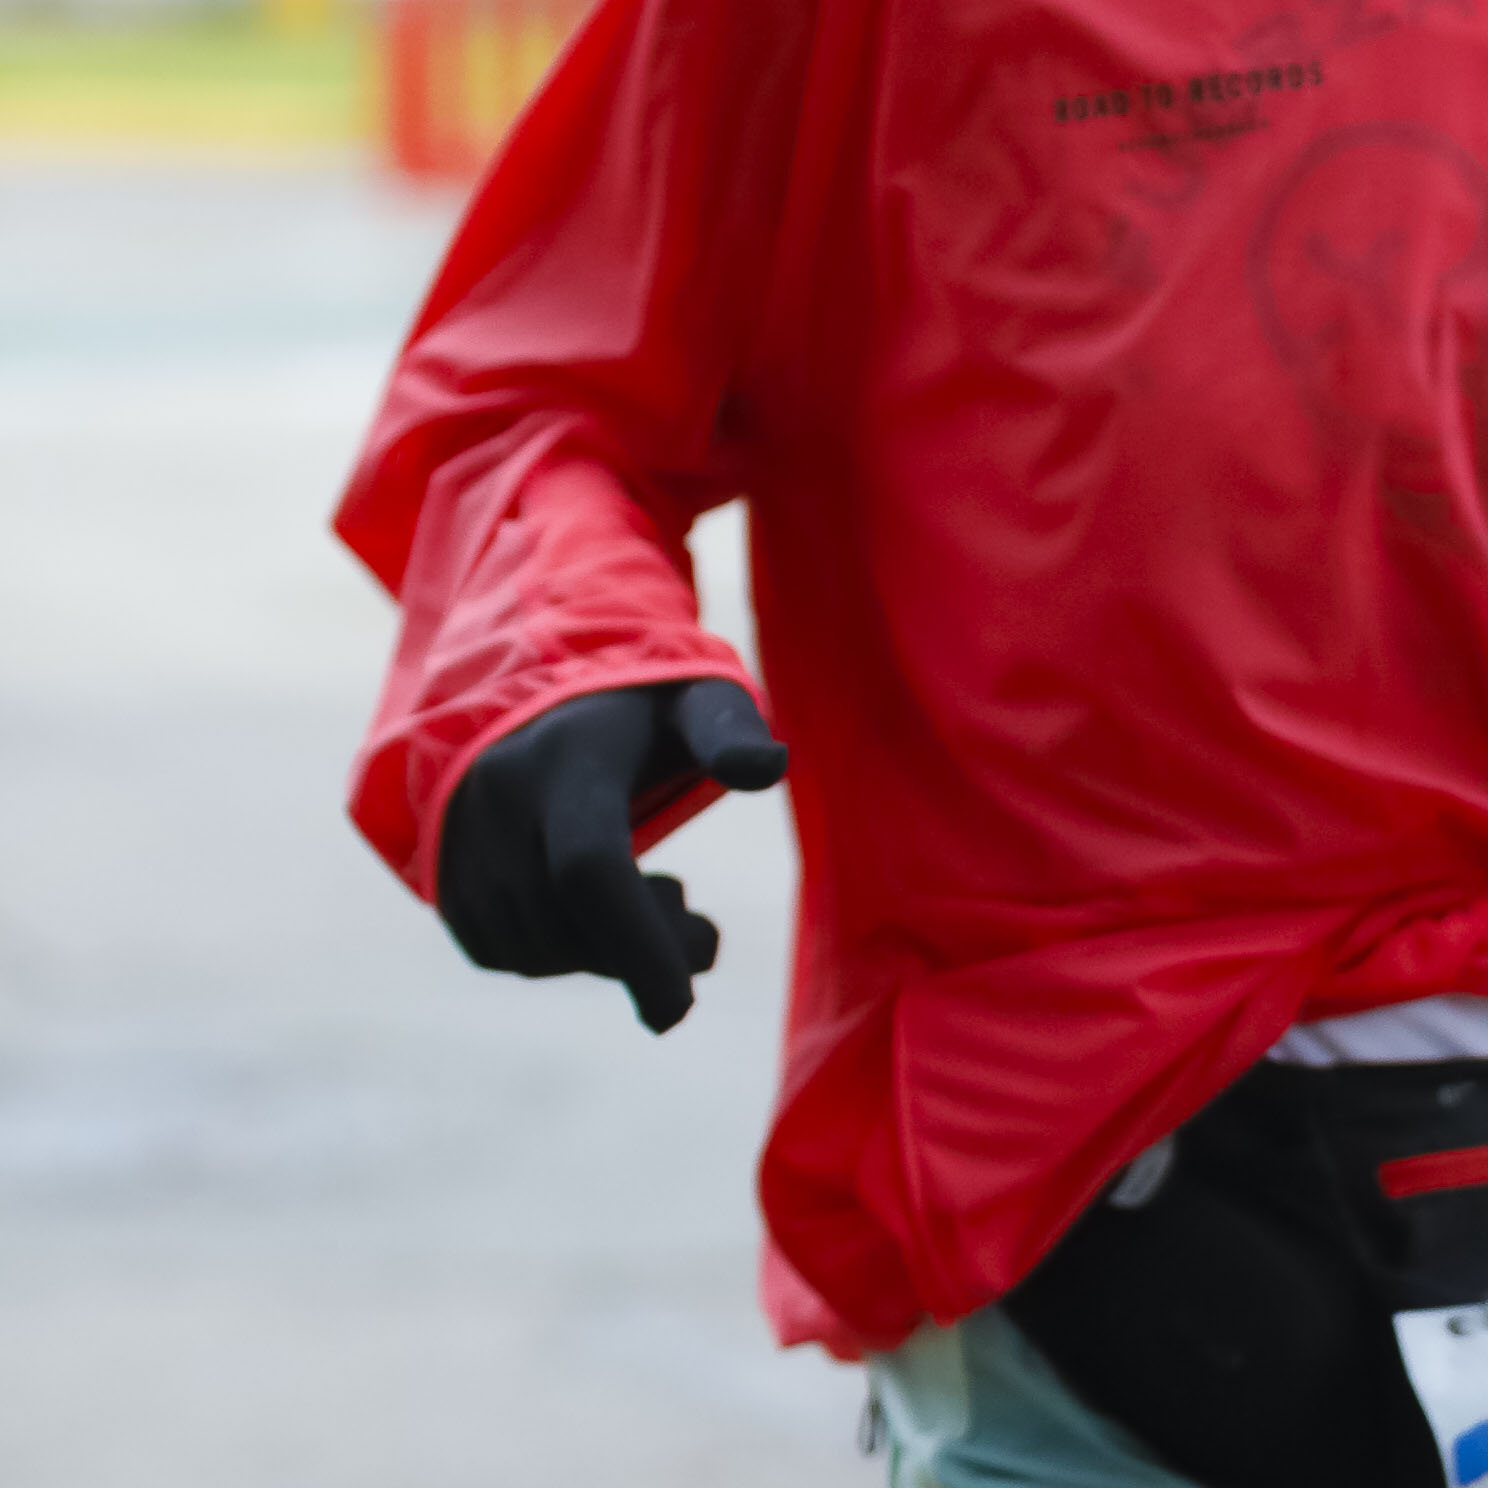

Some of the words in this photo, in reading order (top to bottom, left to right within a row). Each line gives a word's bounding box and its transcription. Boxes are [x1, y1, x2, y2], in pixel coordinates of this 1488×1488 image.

[1054, 89, 1131, 123] ROAD
[1140, 82, 1174, 109] TO
[1188, 60, 1324, 103] RECORDS
